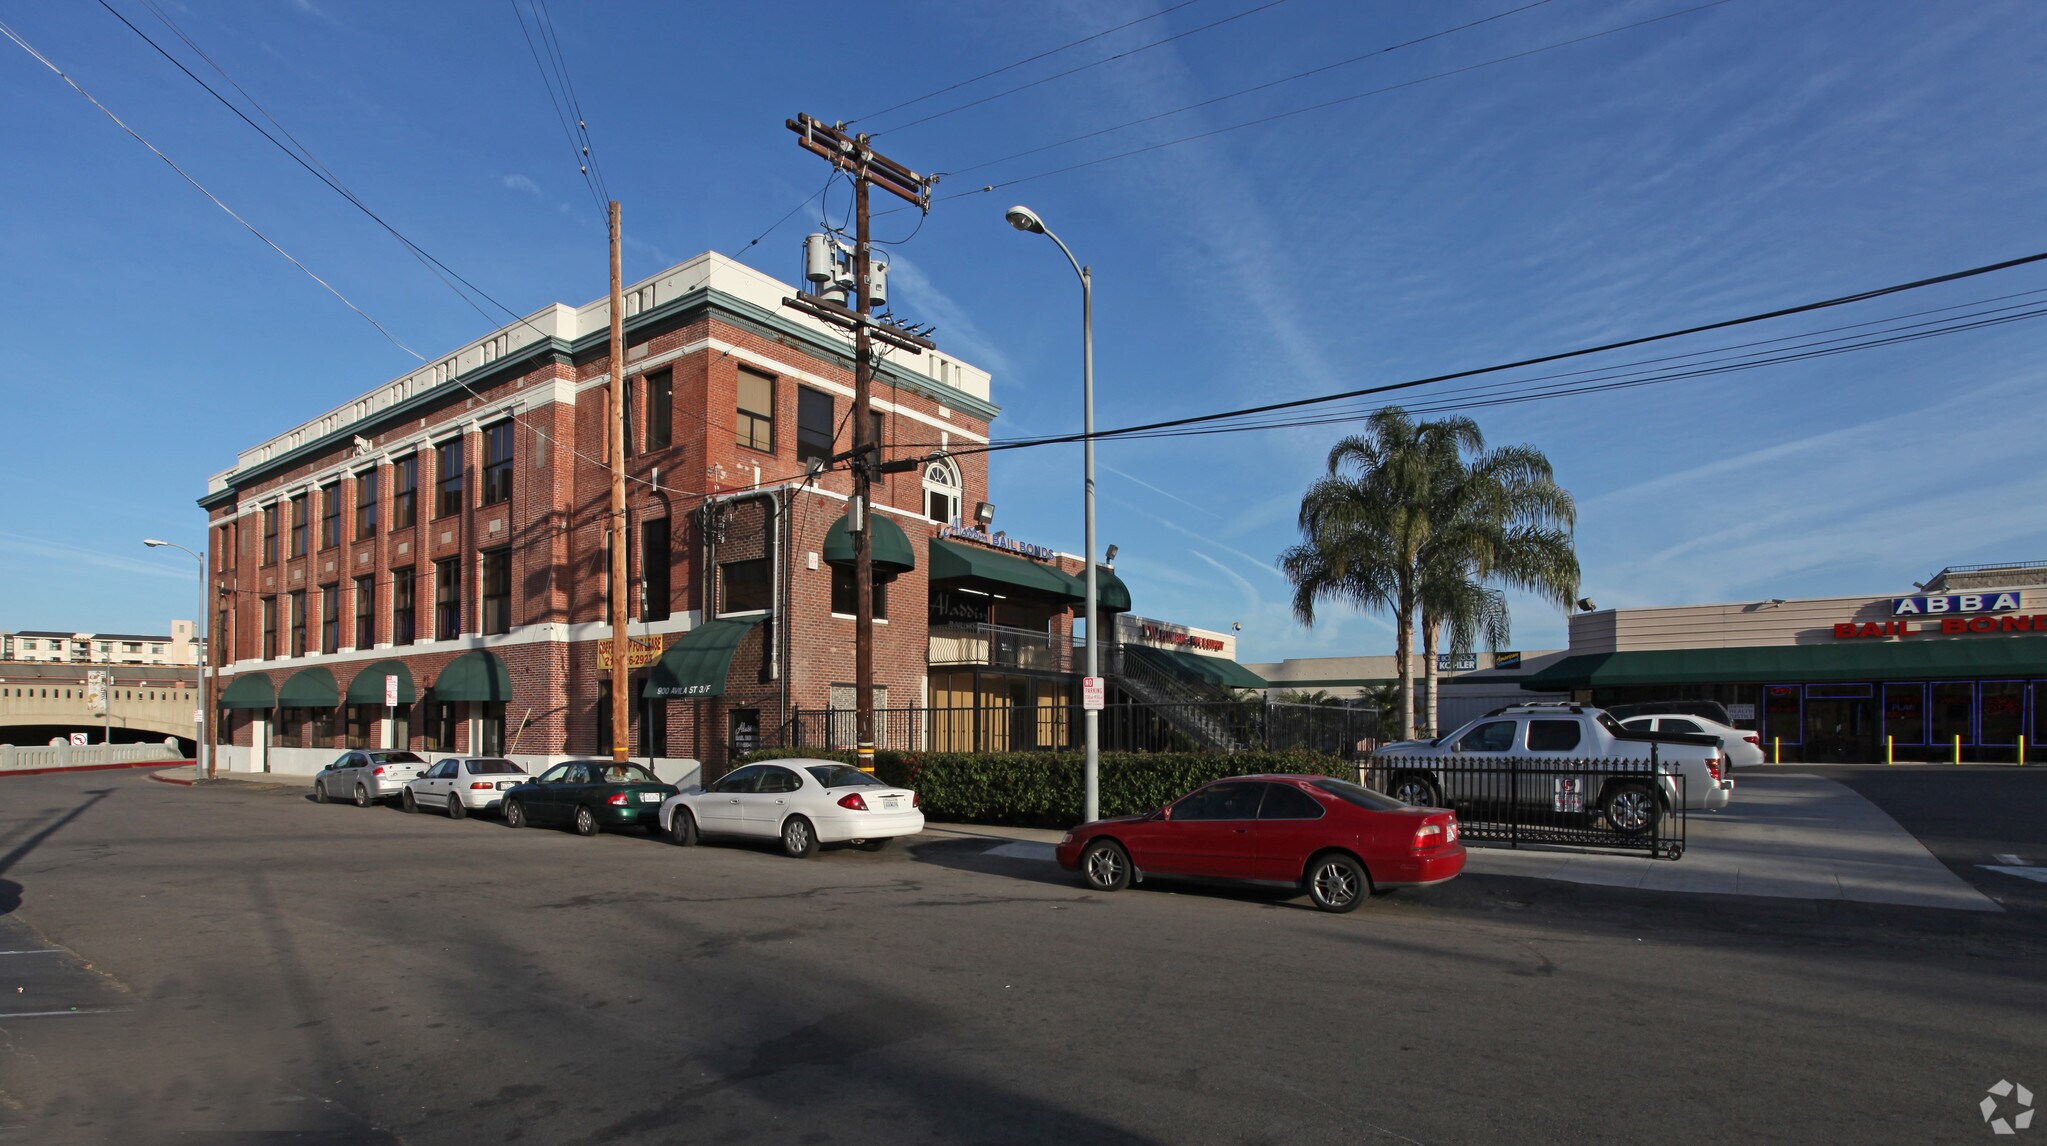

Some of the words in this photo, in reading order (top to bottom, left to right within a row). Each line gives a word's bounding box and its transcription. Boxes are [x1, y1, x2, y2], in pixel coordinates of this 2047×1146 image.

[943, 515, 988, 543] Aladdin
[992, 533, 1017, 550] BAIL
[1019, 541, 1055, 560] BONDS
[930, 591, 989, 621] Aladdin
[1895, 593, 2019, 615] ABBA
[1833, 620, 1920, 638] BAIL
[1439, 660, 1475, 669] KOHLER
[656, 686, 670, 695] 900
[670, 686, 688, 695] AVILA
[688, 685, 698, 694] ST
[699, 684, 711, 694] 3/F
[1084, 678, 1093, 687] NO
